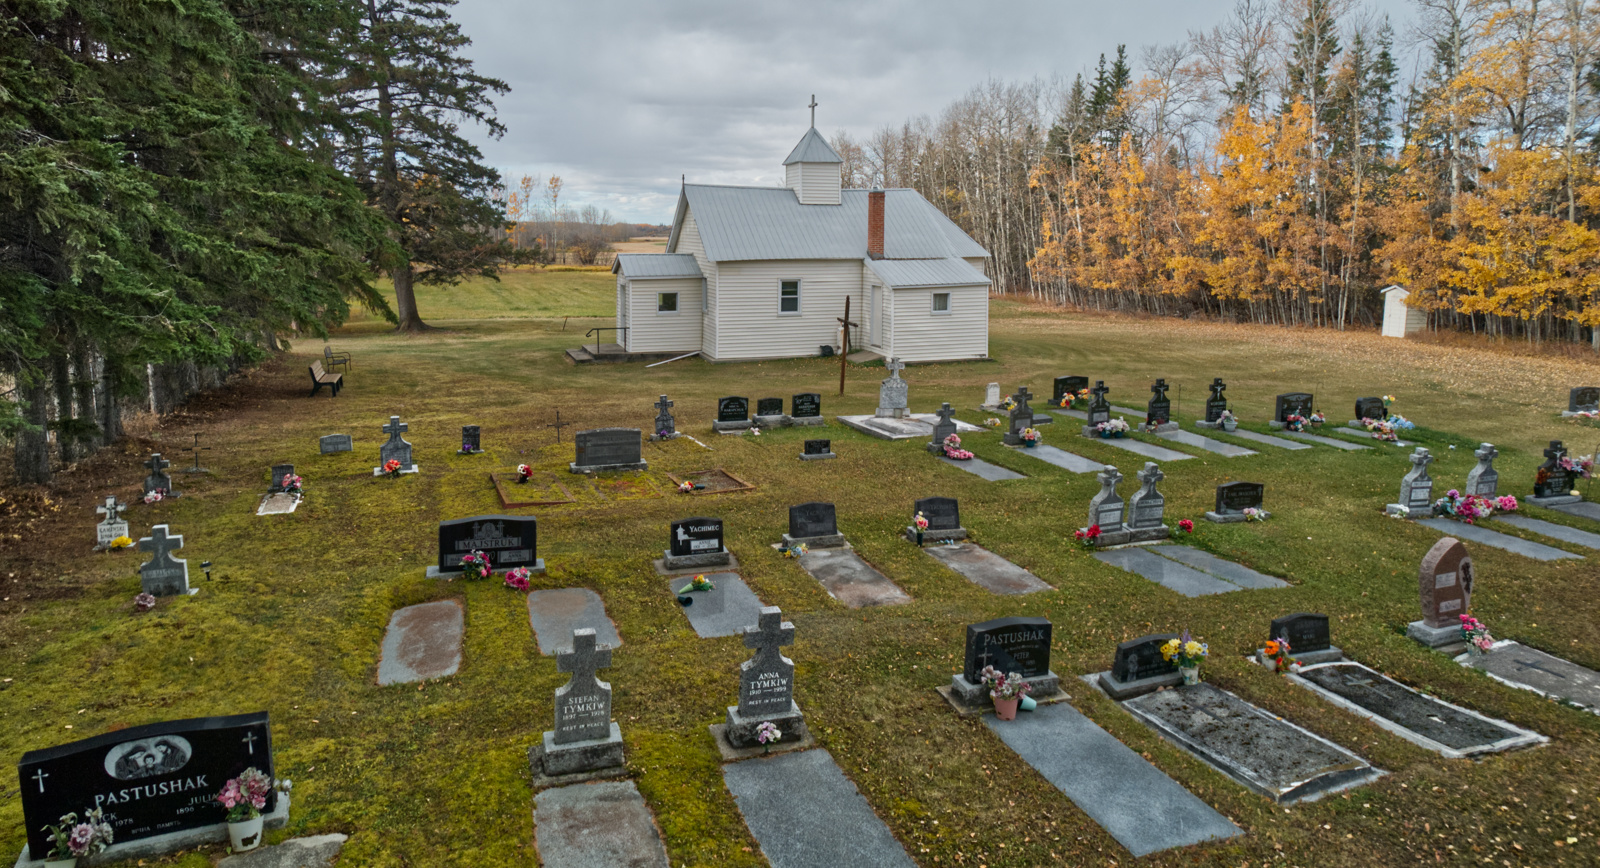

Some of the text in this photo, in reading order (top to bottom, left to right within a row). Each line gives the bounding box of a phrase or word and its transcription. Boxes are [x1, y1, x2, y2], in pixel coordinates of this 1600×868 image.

[689, 524, 720, 533] YACHIMEC
[463, 538, 515, 548] MAJSTRUK
[983, 629, 1044, 646] PASTUSHAK
[758, 672, 780, 680] ANNA
[750, 677, 788, 690] TYMKIW
[568, 694, 599, 705] STEFAN
[563, 701, 605, 714] TYMKIW
[94, 775, 209, 807] PASTUSHAK
[115, 818, 134, 827] 1978
